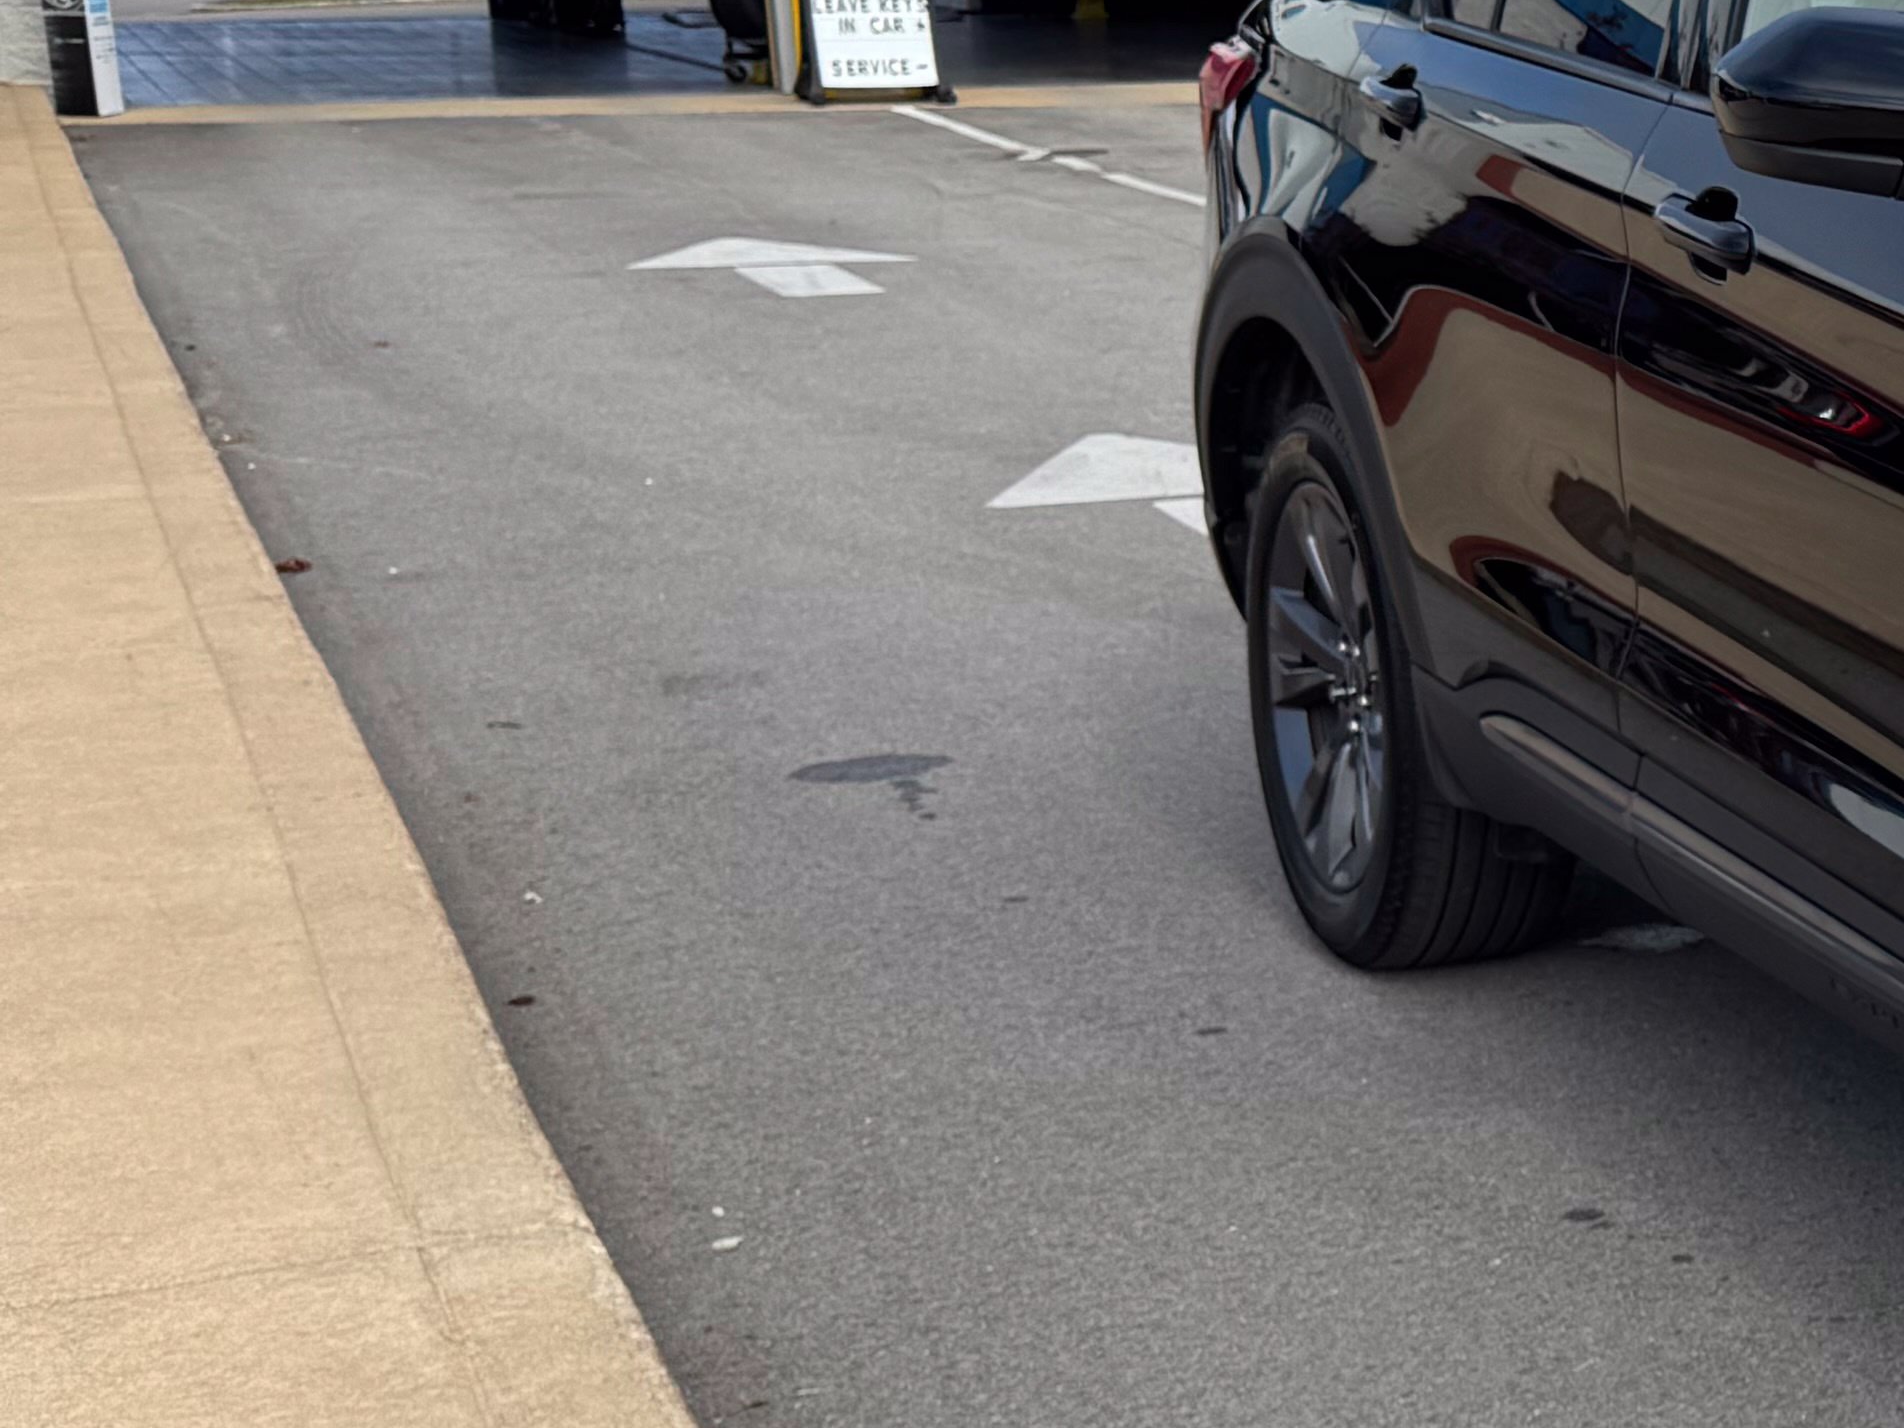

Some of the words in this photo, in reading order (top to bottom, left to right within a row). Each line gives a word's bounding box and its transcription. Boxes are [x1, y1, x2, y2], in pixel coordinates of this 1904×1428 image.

[838, 17, 855, 34] IN
[869, 17, 905, 35] CAR
[831, 59, 911, 77] SERVICE
